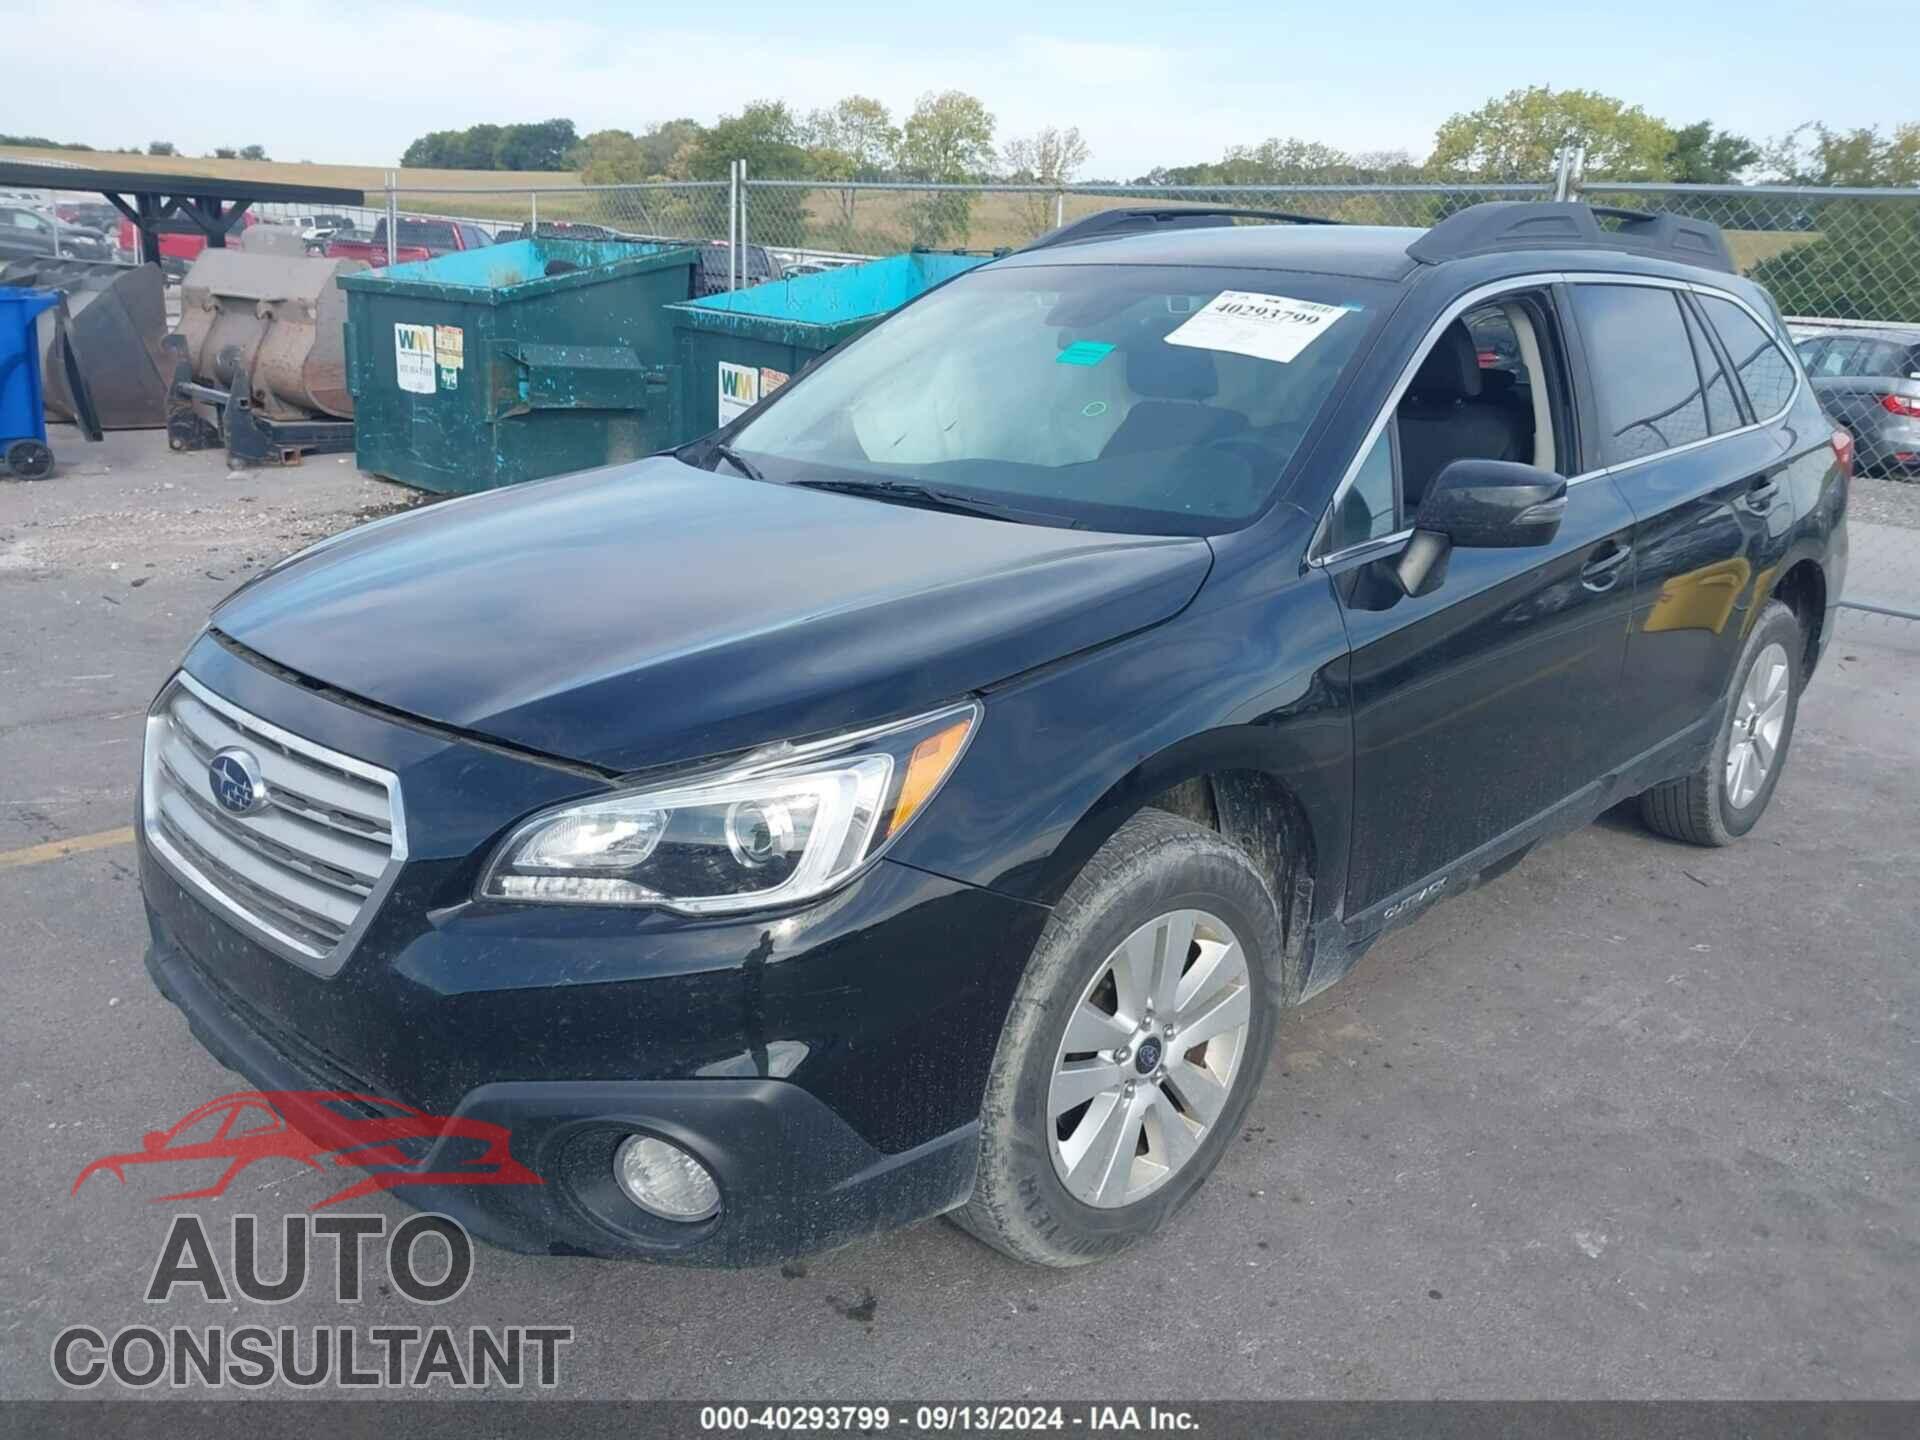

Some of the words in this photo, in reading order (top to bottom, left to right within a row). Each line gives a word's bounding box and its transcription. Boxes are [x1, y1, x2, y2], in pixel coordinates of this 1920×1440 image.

[1215, 302, 1321, 325] 40293799
[398, 328, 429, 351] WM
[721, 368, 754, 400] WM
